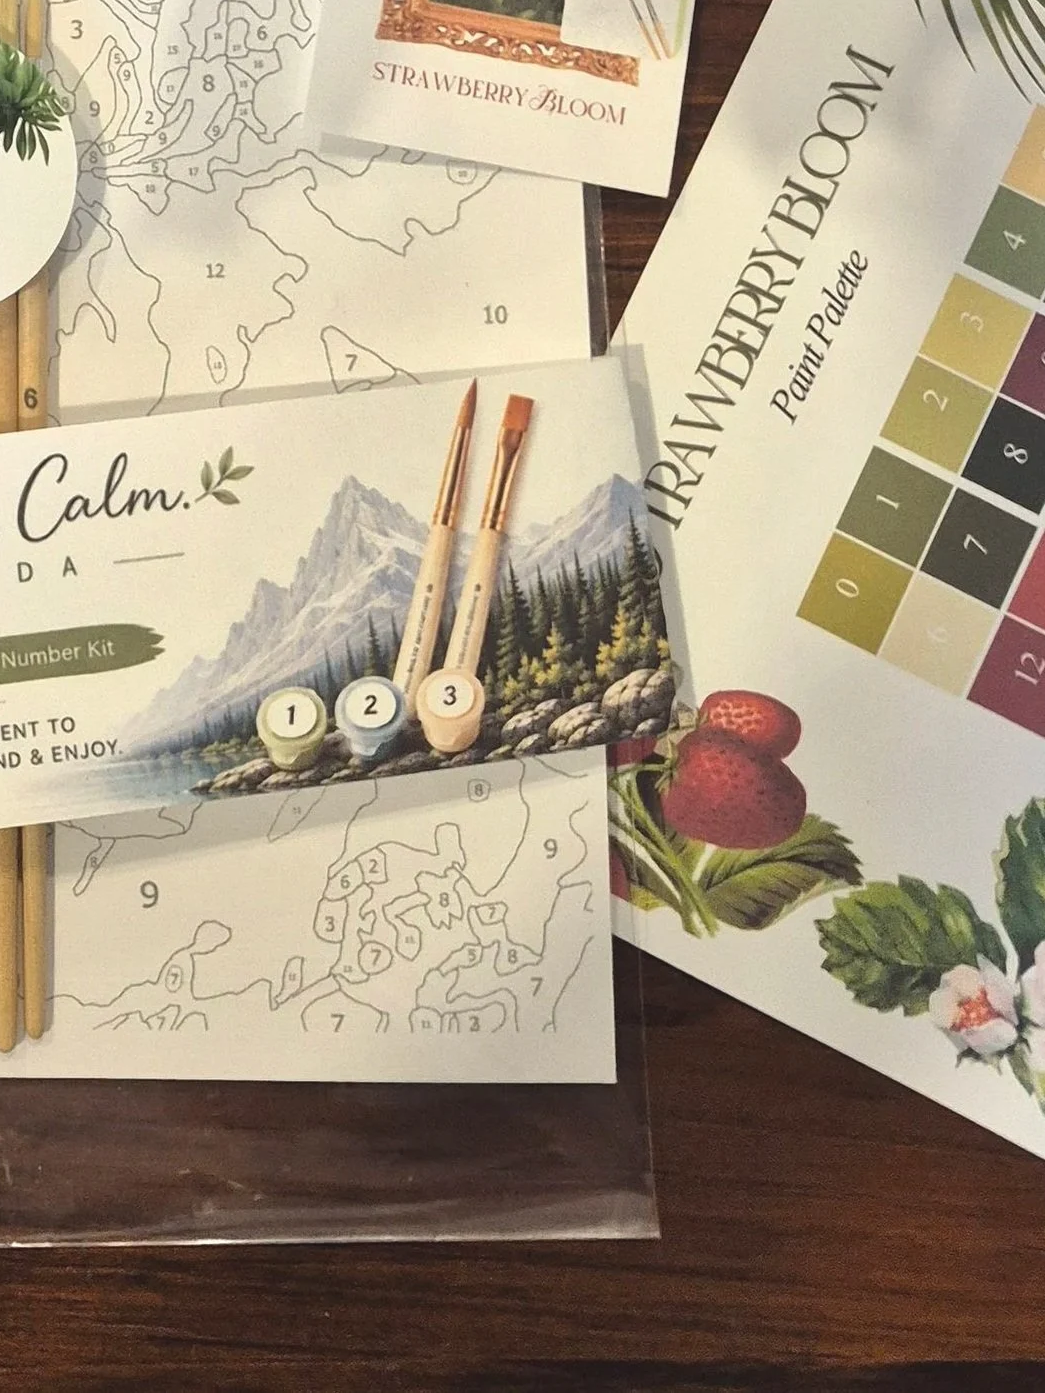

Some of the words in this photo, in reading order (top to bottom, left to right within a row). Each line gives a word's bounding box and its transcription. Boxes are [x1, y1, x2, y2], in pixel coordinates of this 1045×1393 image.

[71, 20, 83, 39] 3
[258, 25, 267, 40] 6
[123, 70, 131, 81] 9
[203, 75, 215, 92] 8
[372, 62, 529, 107] STRAWBERRY
[529, 84, 627, 125] BLOOM
[90, 100, 99, 117] 9
[145, 111, 153, 125] 2
[159, 132, 166, 144] 9
[213, 126, 220, 136] 9
[768, 43, 895, 239] BLOOM
[1003, 229, 1026, 250] 4
[206, 264, 225, 278] 12
[484, 306, 507, 324] 10
[960, 311, 983, 333] 3
[770, 342, 825, 425] Paint
[806, 248, 868, 349] Palette
[346, 355, 357, 371] 7
[24, 388, 37, 409] 6
[923, 389, 949, 411] 2
[1004, 443, 1028, 464] 8
[17, 452, 190, 543] Calm.
[876, 494, 899, 510] 1
[963, 533, 988, 556] 7
[835, 578, 859, 598] 0
[87, 640, 115, 658] Kit
[1015, 651, 1045, 686] 12
[364, 694, 378, 715] 2
[443, 686, 457, 705] 3
[287, 705, 296, 725] 1
[47, 716, 75, 734] TO
[30, 749, 43, 765] &
[51, 739, 123, 768] ENJOY.
[543, 839, 557, 858] 9
[369, 860, 378, 873] 2
[340, 875, 350, 889] 6
[141, 881, 158, 908] 9
[440, 894, 449, 907] 8
[325, 917, 334, 932] 3
[371, 950, 381, 964] 7
[531, 978, 542, 996] 7
[331, 1015, 344, 1031] 7
